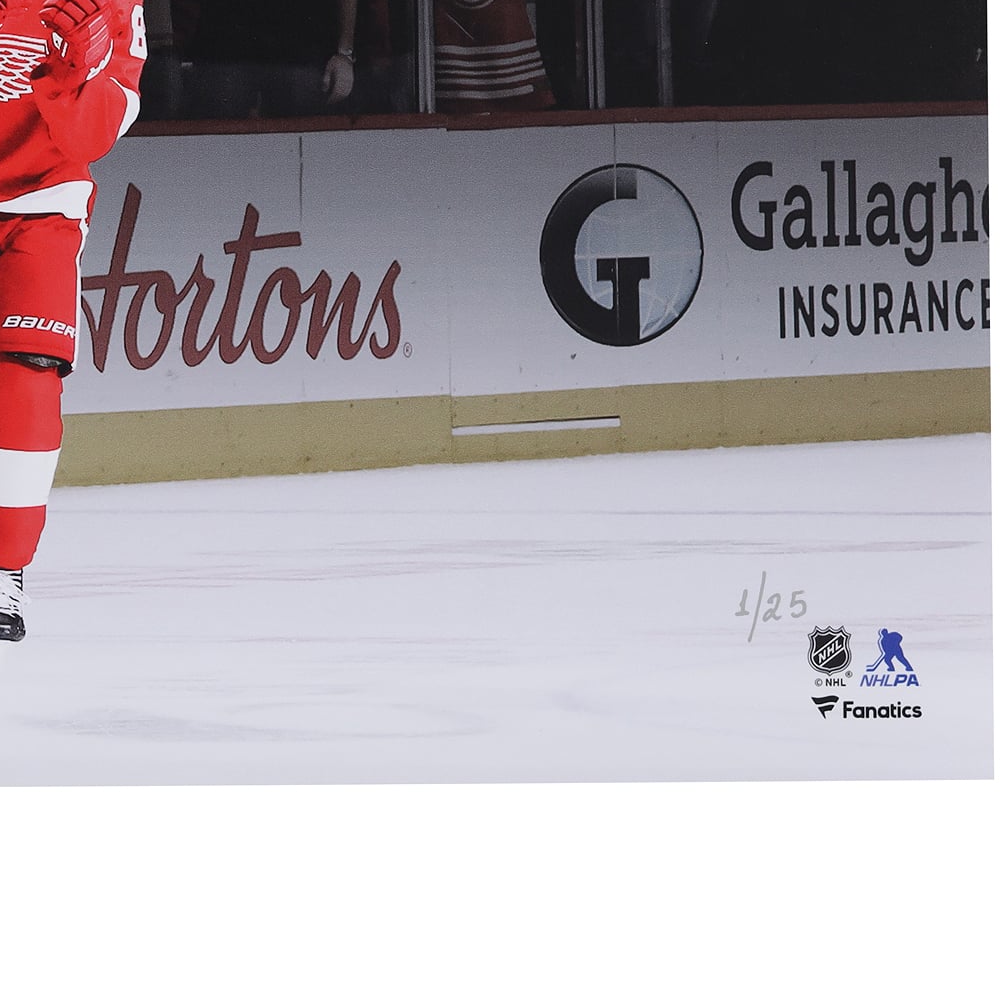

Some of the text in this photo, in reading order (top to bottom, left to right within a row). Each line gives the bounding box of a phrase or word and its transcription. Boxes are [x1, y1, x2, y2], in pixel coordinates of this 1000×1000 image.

[731, 156, 989, 267] Gallagh
[734, 570, 808, 643] 1/25
[818, 639, 842, 663] NHL
[825, 678, 847, 687] NHL
[860, 674, 920, 687] NHLPA
[842, 700, 923, 719] Fanatics
